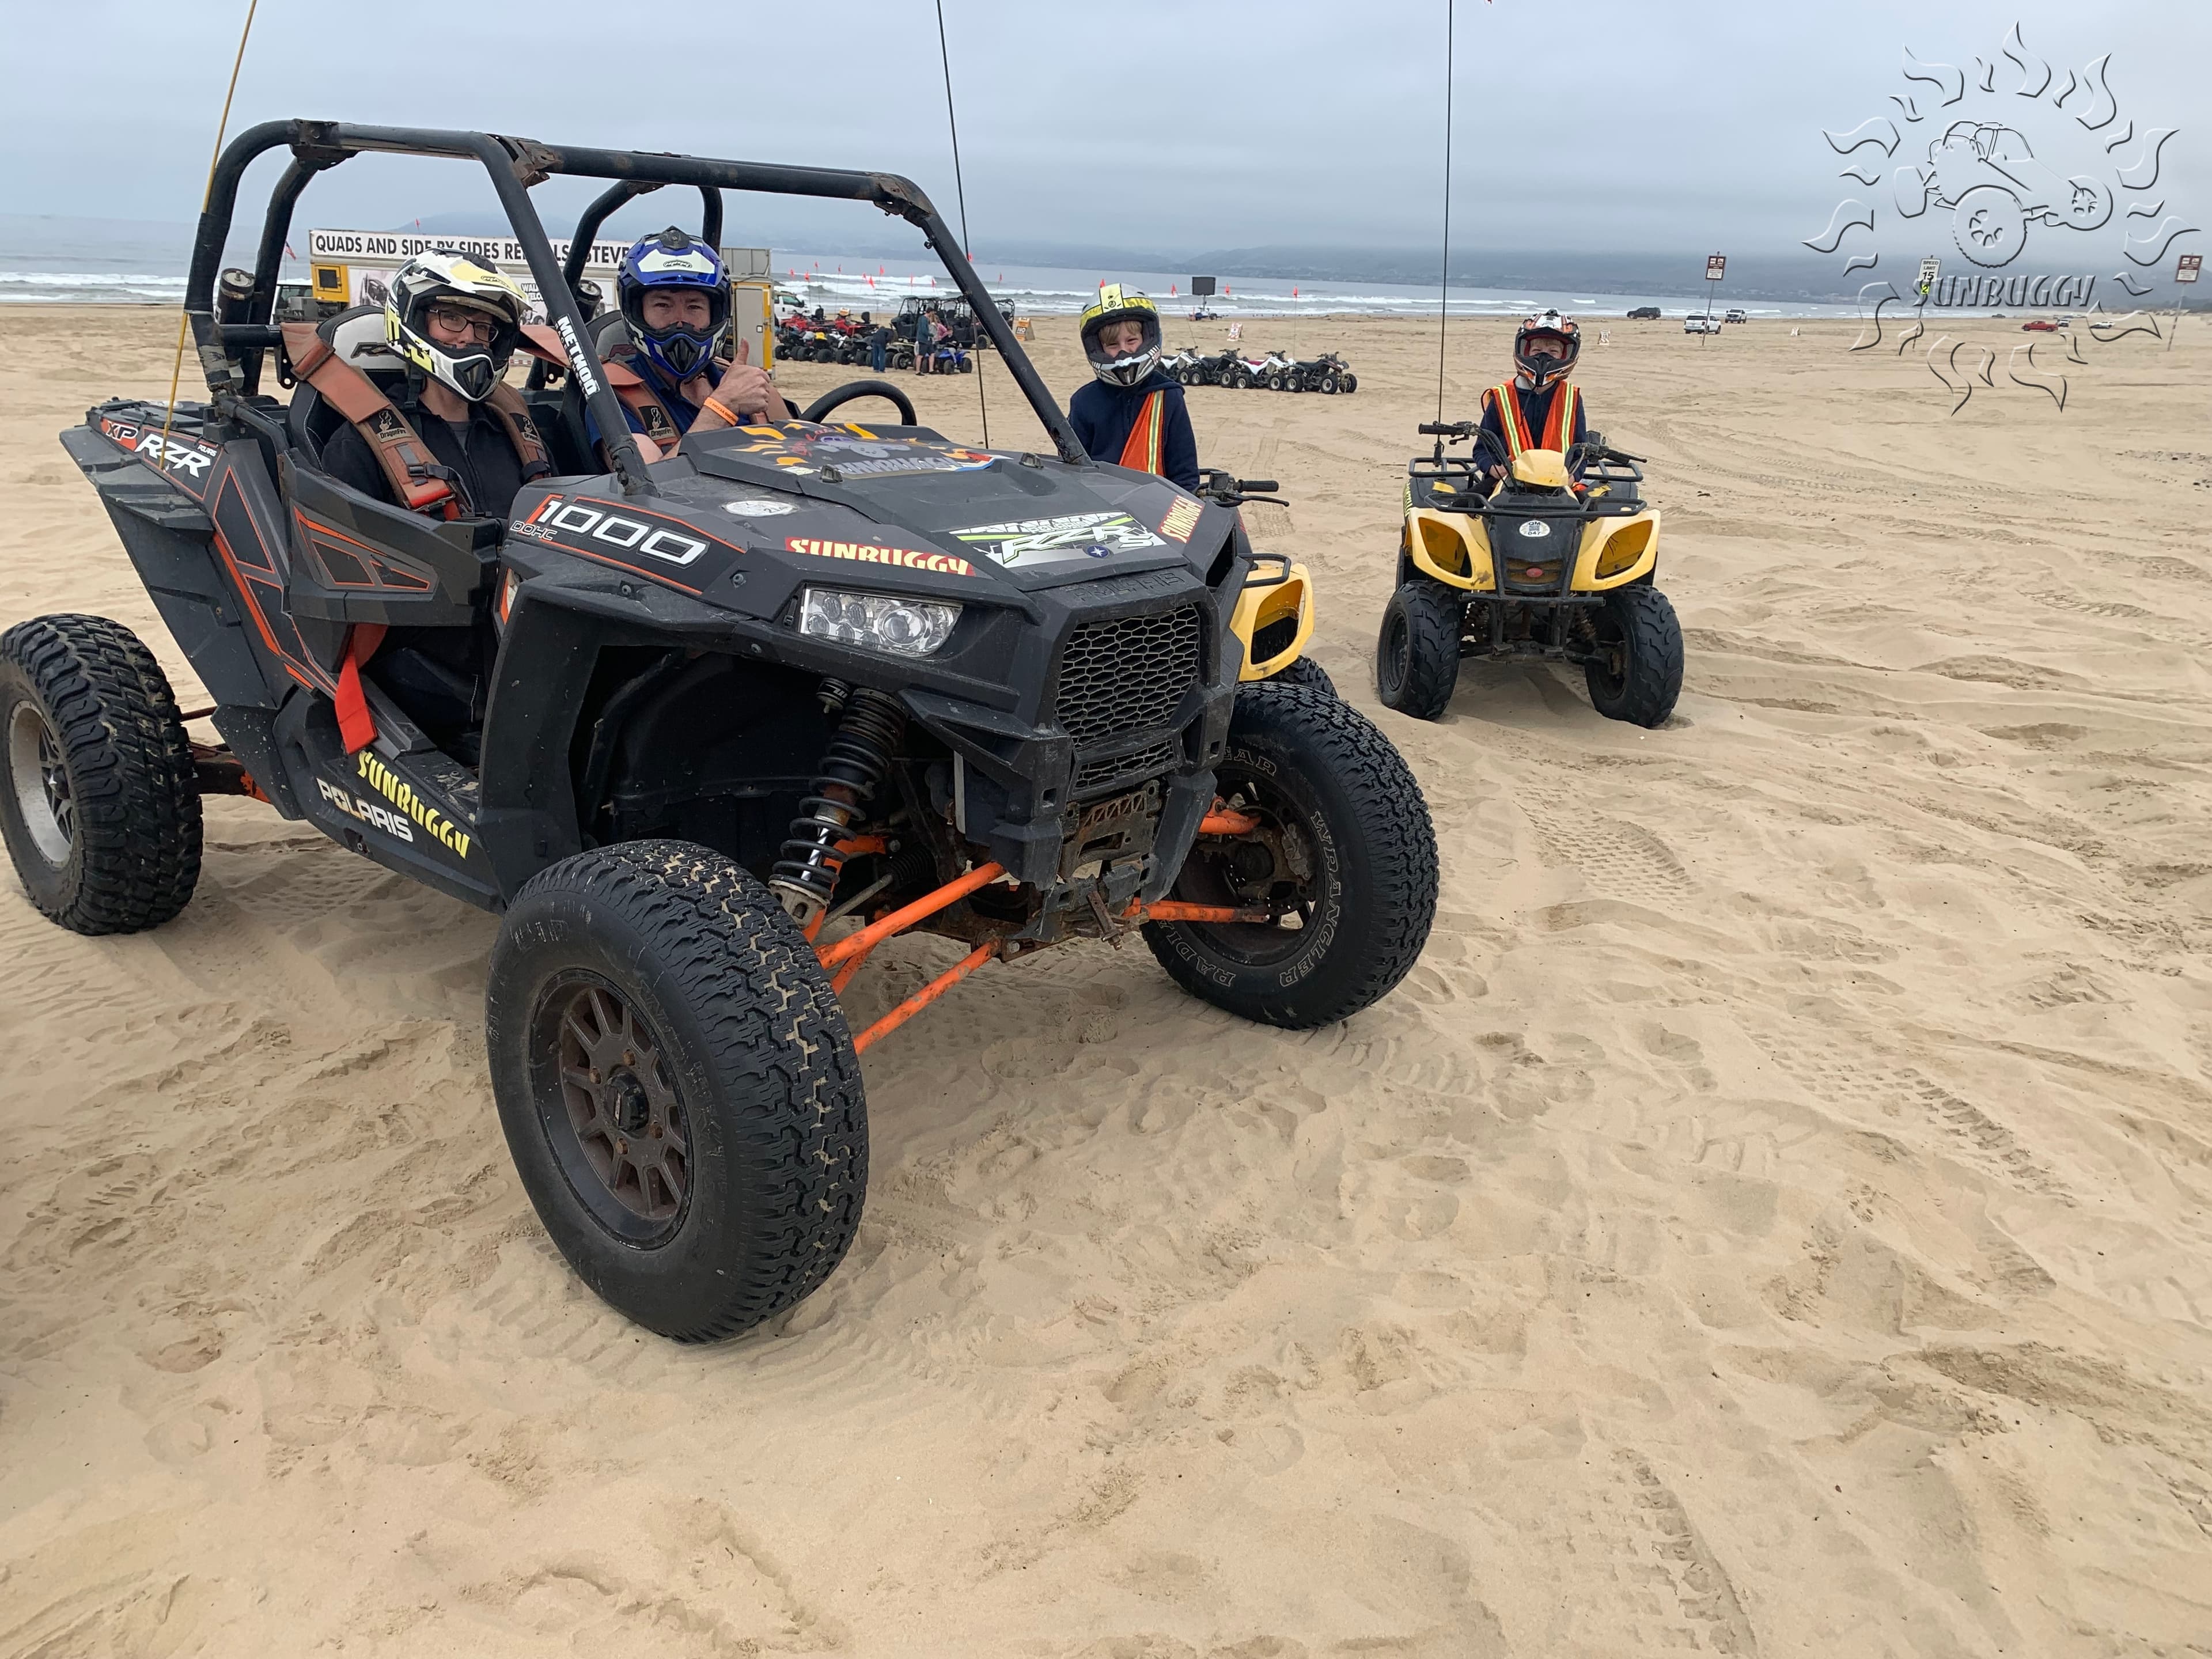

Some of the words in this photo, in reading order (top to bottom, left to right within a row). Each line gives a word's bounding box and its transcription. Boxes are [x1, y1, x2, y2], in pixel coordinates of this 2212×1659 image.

[316, 234, 362, 253] QUADS
[366, 237, 397, 255] AND
[505, 243, 569, 262] RELS
[1922, 285, 1929, 293] 2
[1923, 271, 1935, 281] 15
[556, 316, 597, 396] METHOD
[105, 421, 139, 442] XP
[134, 433, 211, 478] RZR
[197, 444, 218, 457] POLARIS
[510, 520, 558, 541] DOHC
[537, 499, 707, 565] 1000
[1027, 521, 1090, 534] POLARIS
[790, 539, 969, 575] SUNBUGGY
[1001, 525, 1141, 565] RZR
[1066, 572, 1185, 602] POLARIS
[316, 778, 414, 842] POLARIS
[357, 751, 471, 860] SUNBUGGY
[1279, 810, 1342, 987] WRANGLER
[1157, 919, 1237, 987] RADIA
